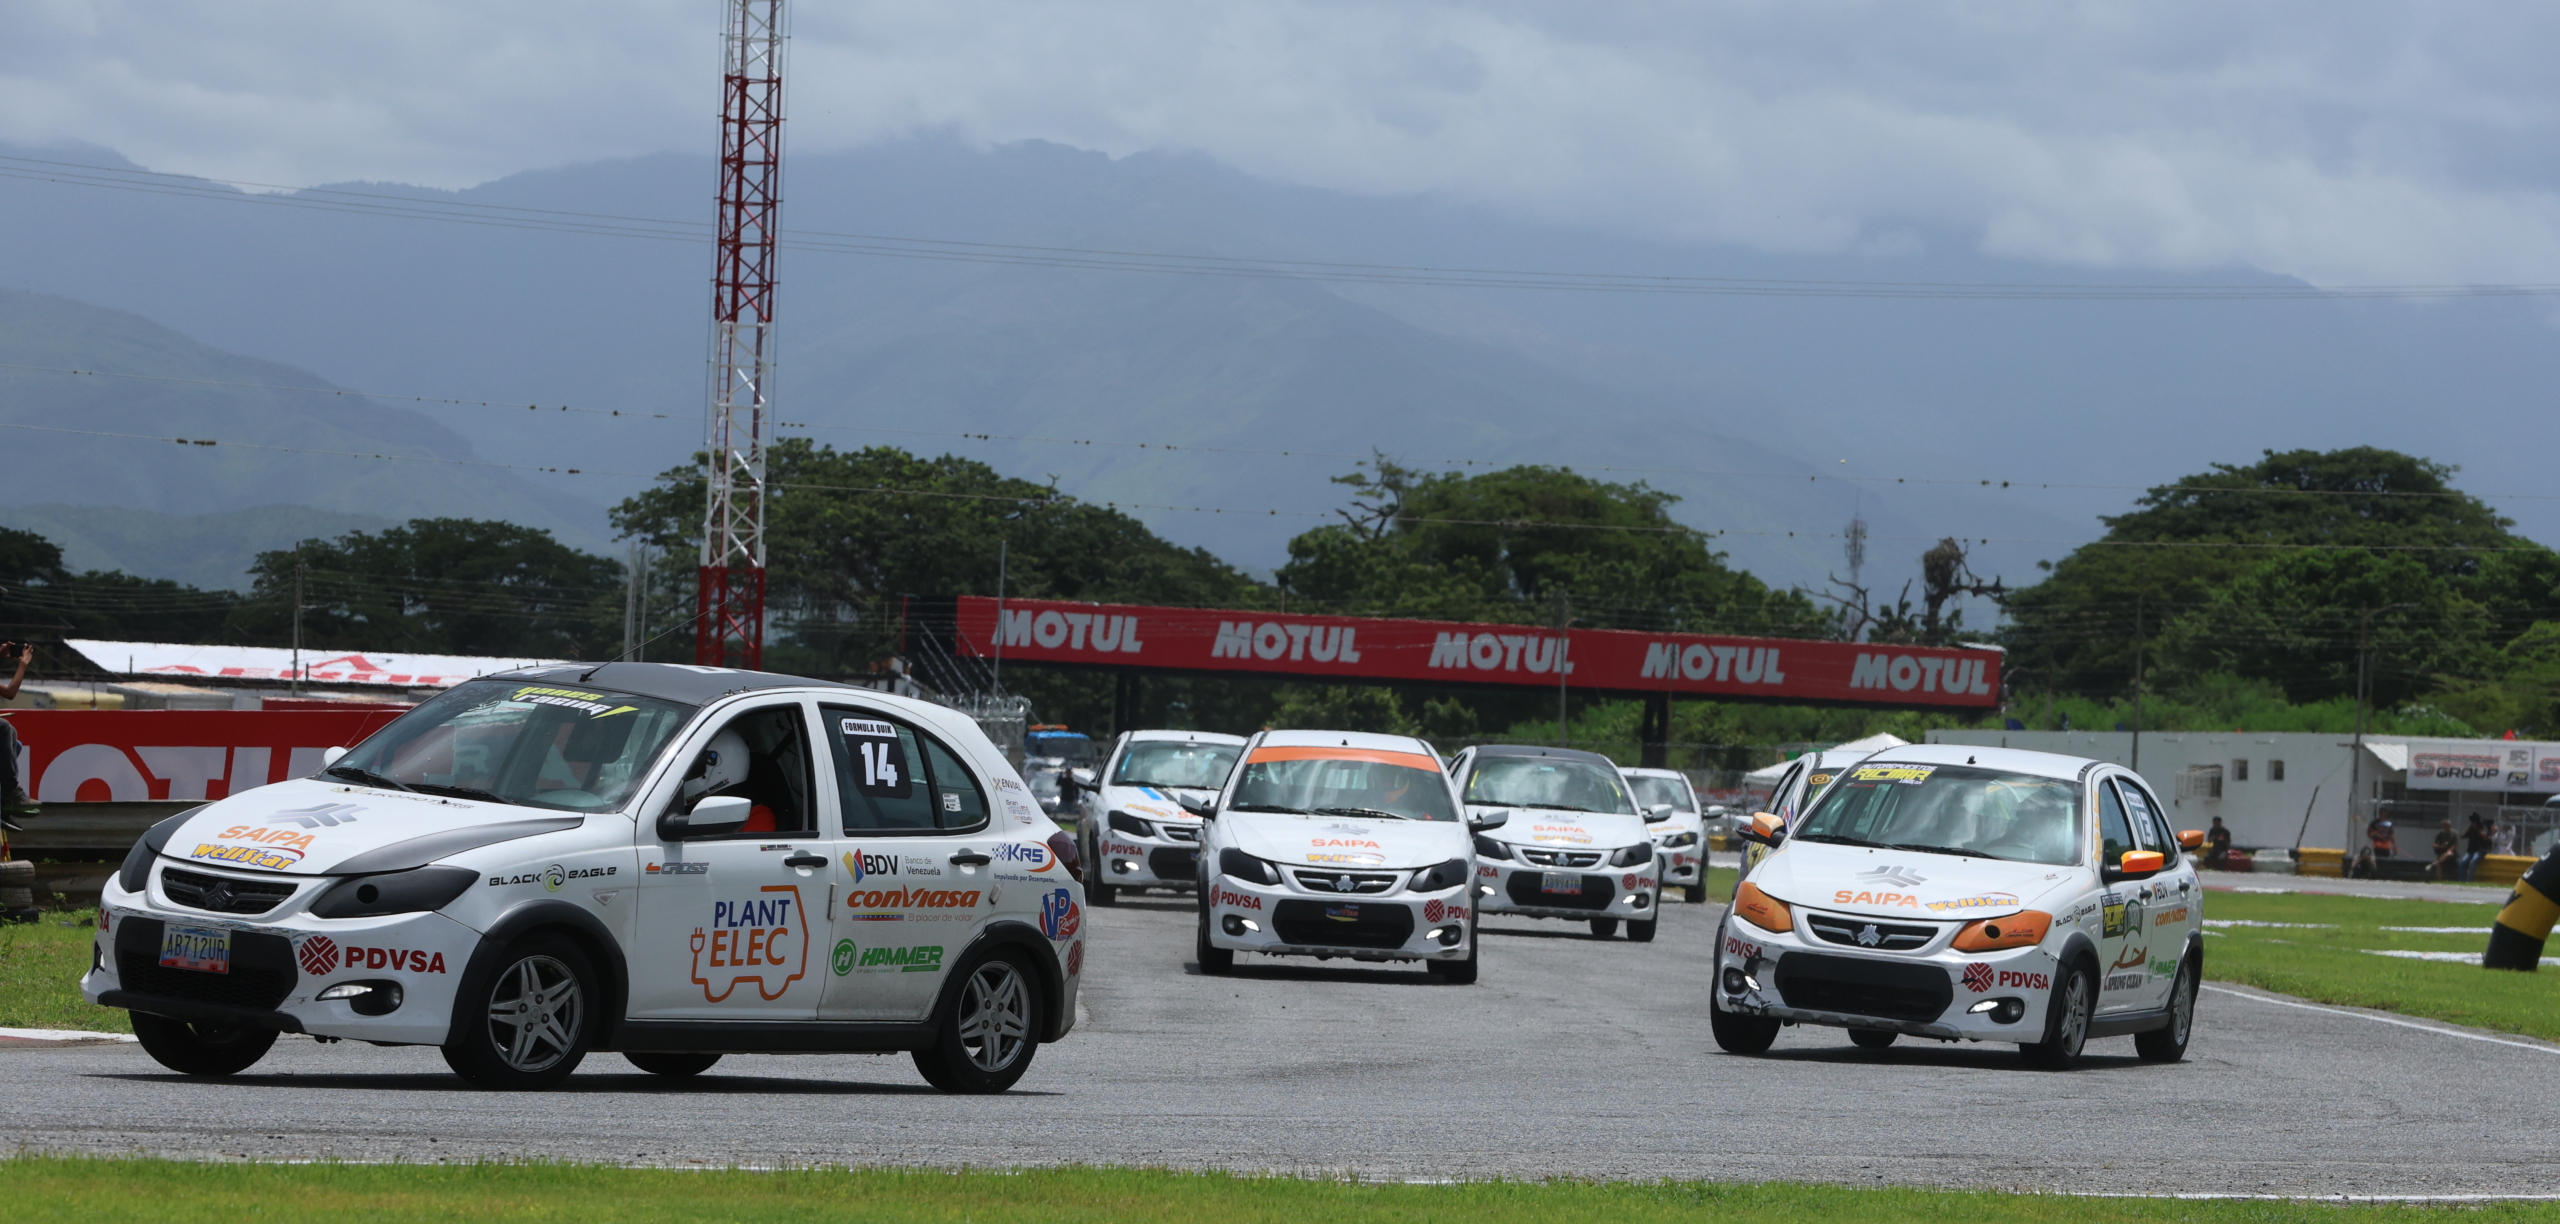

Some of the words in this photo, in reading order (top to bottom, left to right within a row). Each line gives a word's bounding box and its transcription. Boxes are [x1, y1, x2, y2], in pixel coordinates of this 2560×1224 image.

[991, 609, 1143, 653] MOTUL
[1211, 620, 1362, 663] MOTUL
[1428, 632, 1575, 674] MOTUL
[1641, 642, 1785, 684] MOTUL
[1850, 653, 1991, 695] MOTUL
[845, 722, 875, 733] FORMULA
[876, 724, 892, 734] QUIK
[861, 742, 898, 787] 14
[2437, 766, 2499, 779] GROUP
[217, 825, 316, 850] SAIPA
[1311, 838, 1380, 849] SAIPA
[190, 843, 298, 871] WellStar
[905, 855, 924, 865] Banco
[925, 857, 932, 865] de
[1007, 843, 1044, 863] KRS
[1110, 844, 1144, 856] PDVSA
[661, 862, 710, 875] CROSS
[863, 854, 898, 875] BDV
[906, 866, 941, 876] Venezuela
[489, 872, 542, 886] BLACK
[1220, 890, 1262, 910] PDVSA
[1834, 890, 1919, 908] SAIPA
[1924, 896, 2020, 913] WellStar
[714, 899, 791, 928] PLANT
[908, 913, 914, 922] El
[916, 913, 940, 923] placer
[942, 914, 952, 922] de
[955, 913, 973, 922] volar
[2056, 914, 2074, 927] BLACK
[165, 933, 226, 962] AB712UR
[709, 927, 789, 967] ELEC
[858, 946, 944, 967] HAMMER
[345, 946, 447, 974] PDVSA
[1999, 971, 2049, 990] PDVSA
[2108, 975, 2125, 991] SPRING
[2126, 973, 2144, 989] CLEAN
